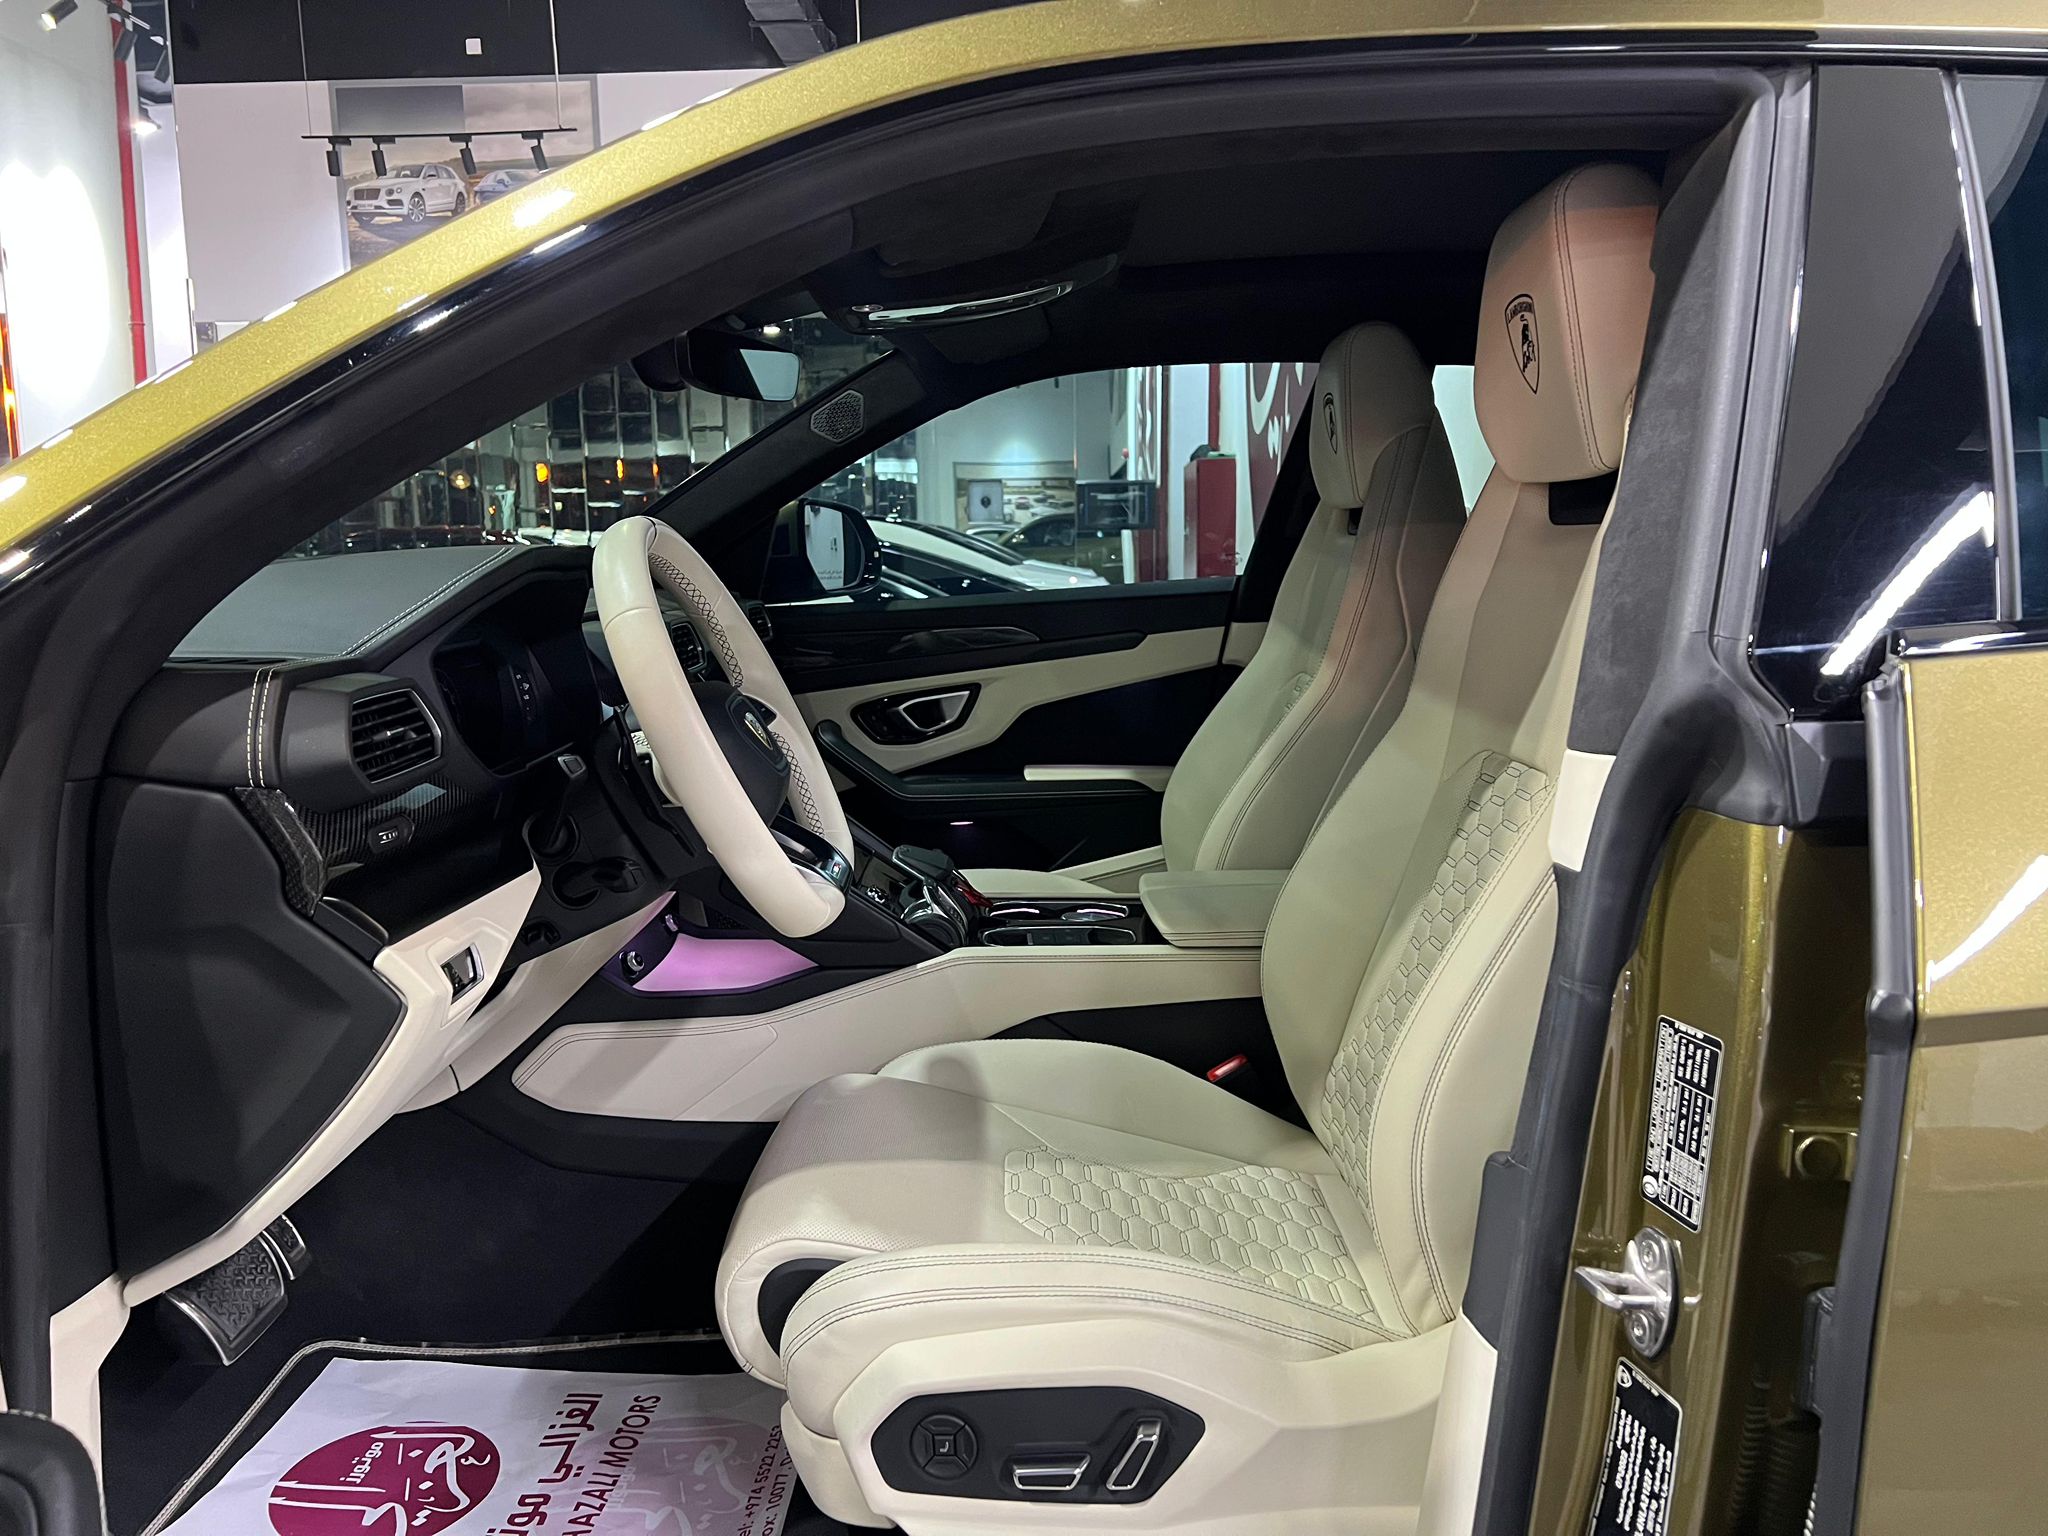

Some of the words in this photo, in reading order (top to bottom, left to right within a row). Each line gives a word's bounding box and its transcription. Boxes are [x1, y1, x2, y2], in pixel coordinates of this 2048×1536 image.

[538, 1393, 603, 1484] الغزالي
[599, 1395, 661, 1468] MOTORS
[340, 1441, 384, 1484] موتورز
[754, 1453, 776, 1484] 5522
[745, 1485, 765, 1518] +974
[766, 1474, 789, 1511] 10077
